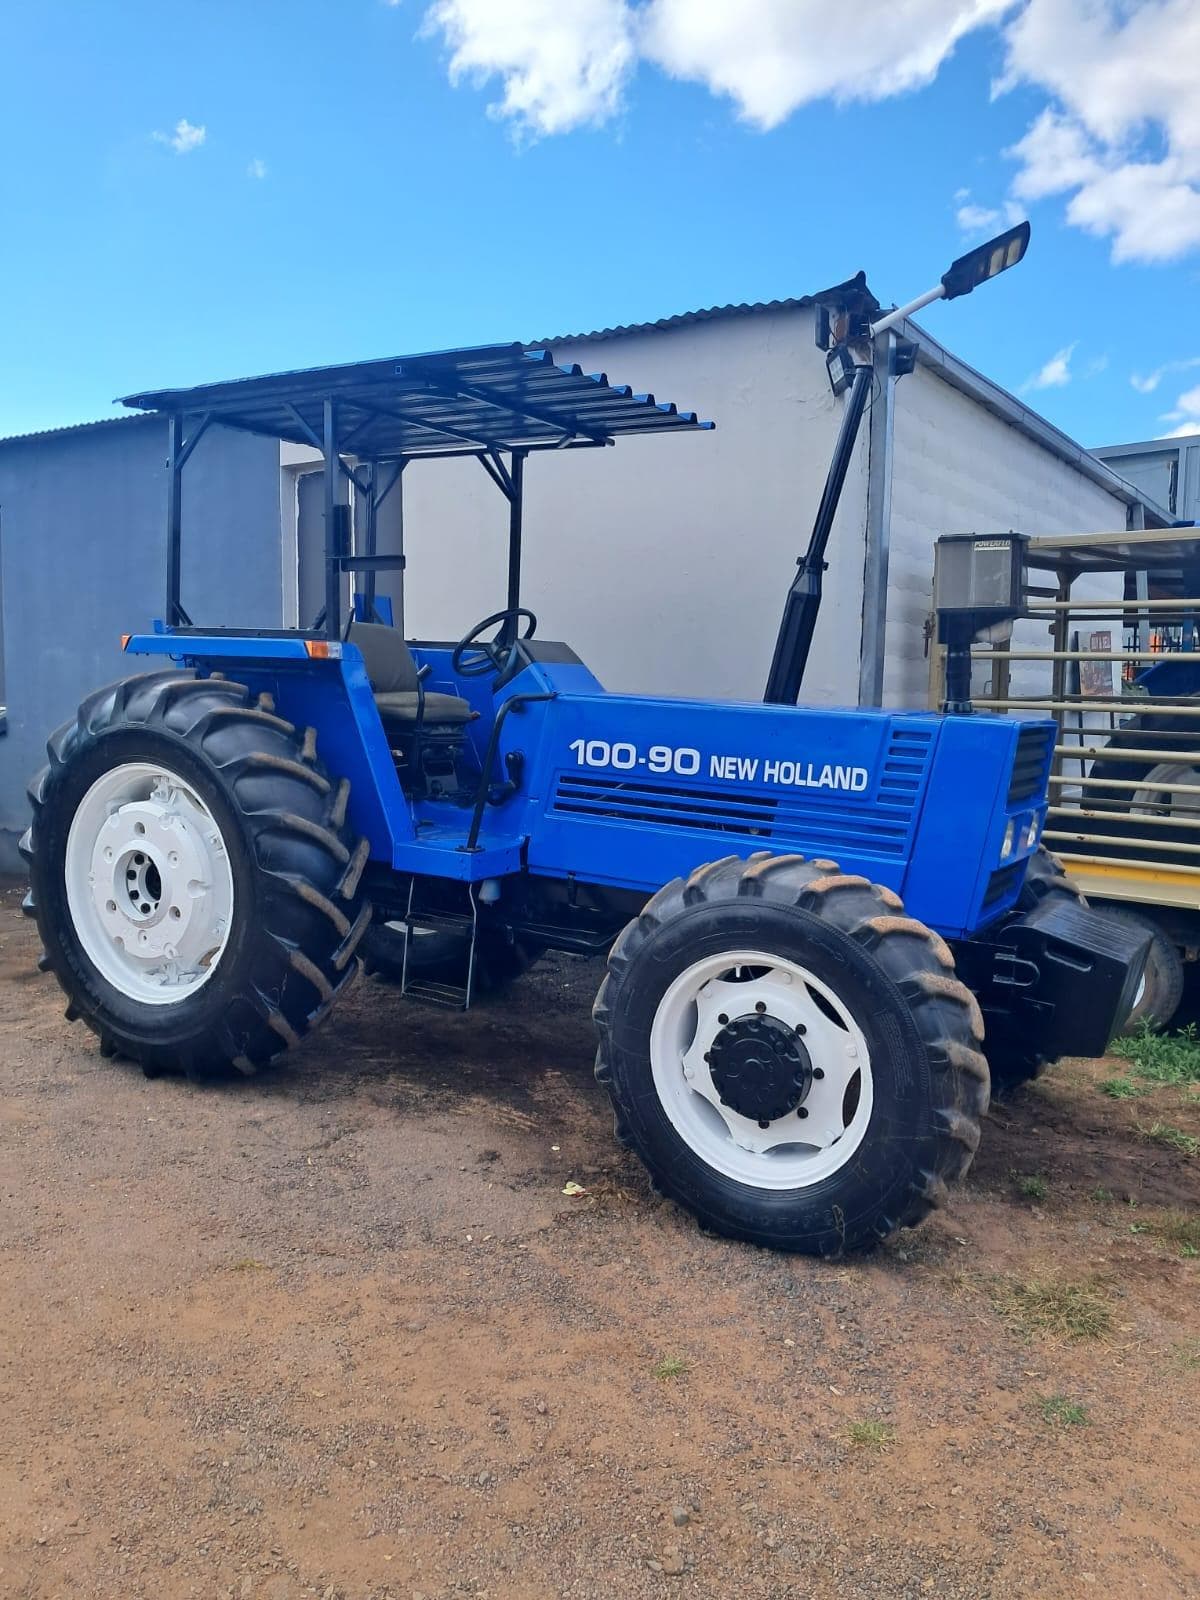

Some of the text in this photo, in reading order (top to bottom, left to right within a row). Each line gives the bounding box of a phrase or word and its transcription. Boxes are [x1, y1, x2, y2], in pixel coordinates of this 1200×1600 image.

[569, 739, 868, 792] 100-90 NEW HOLLAND
